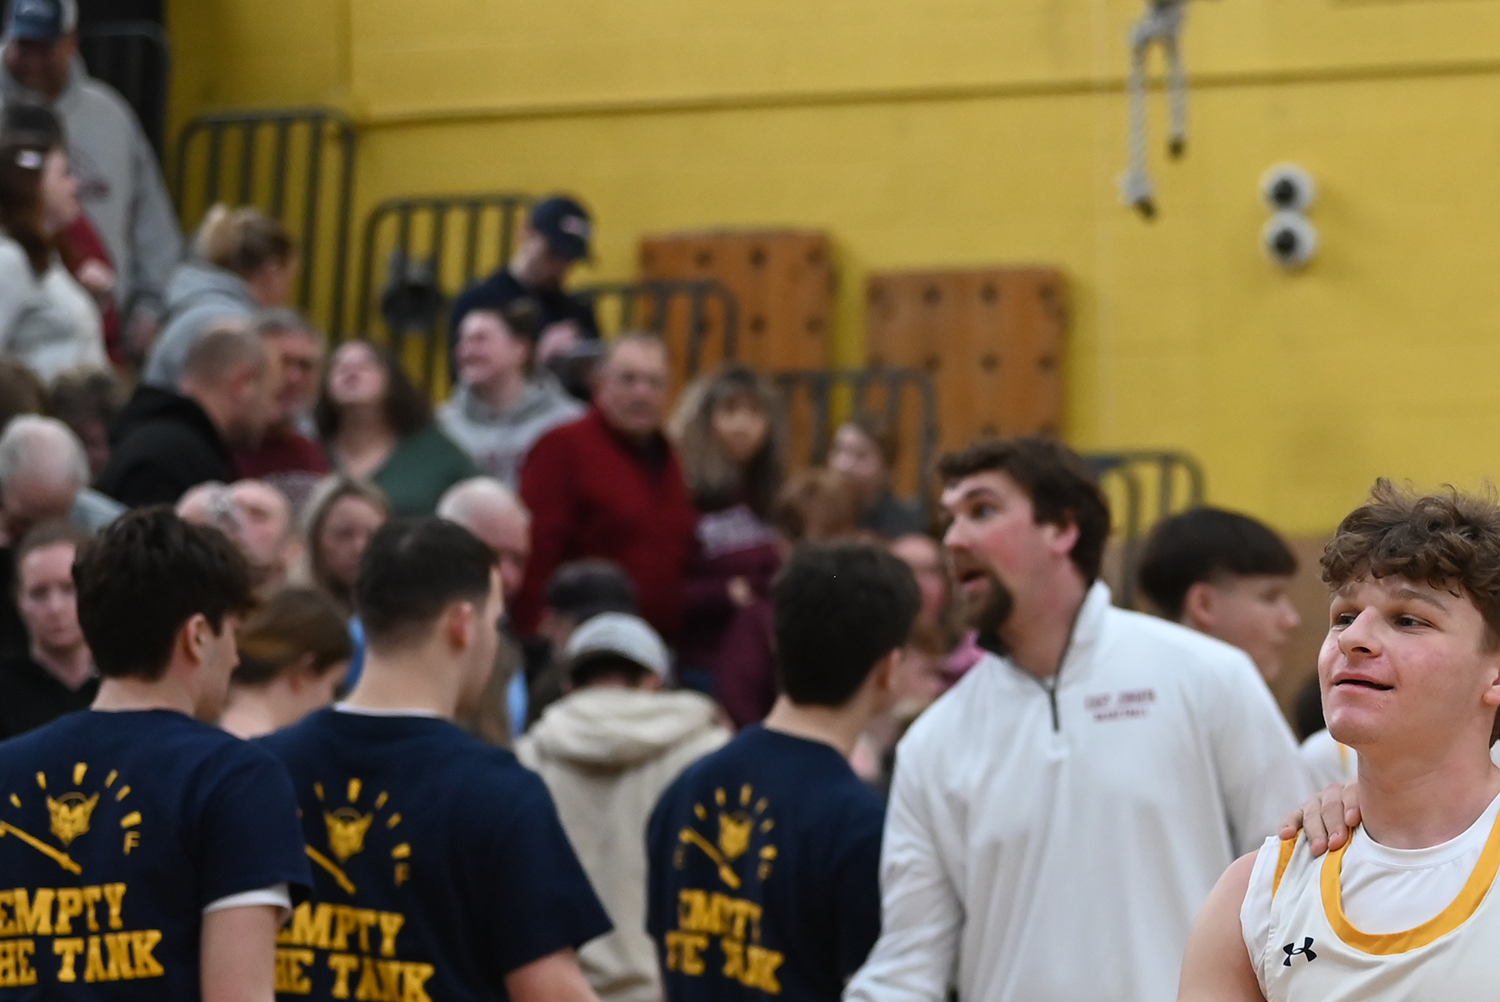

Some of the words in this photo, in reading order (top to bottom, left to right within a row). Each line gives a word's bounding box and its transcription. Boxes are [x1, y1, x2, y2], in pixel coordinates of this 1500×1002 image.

[124, 831, 140, 854] F
[276, 902, 405, 957] MPTY
[0, 938, 37, 987] HE
[53, 930, 164, 982] TANK
[275, 949, 315, 994] HE
